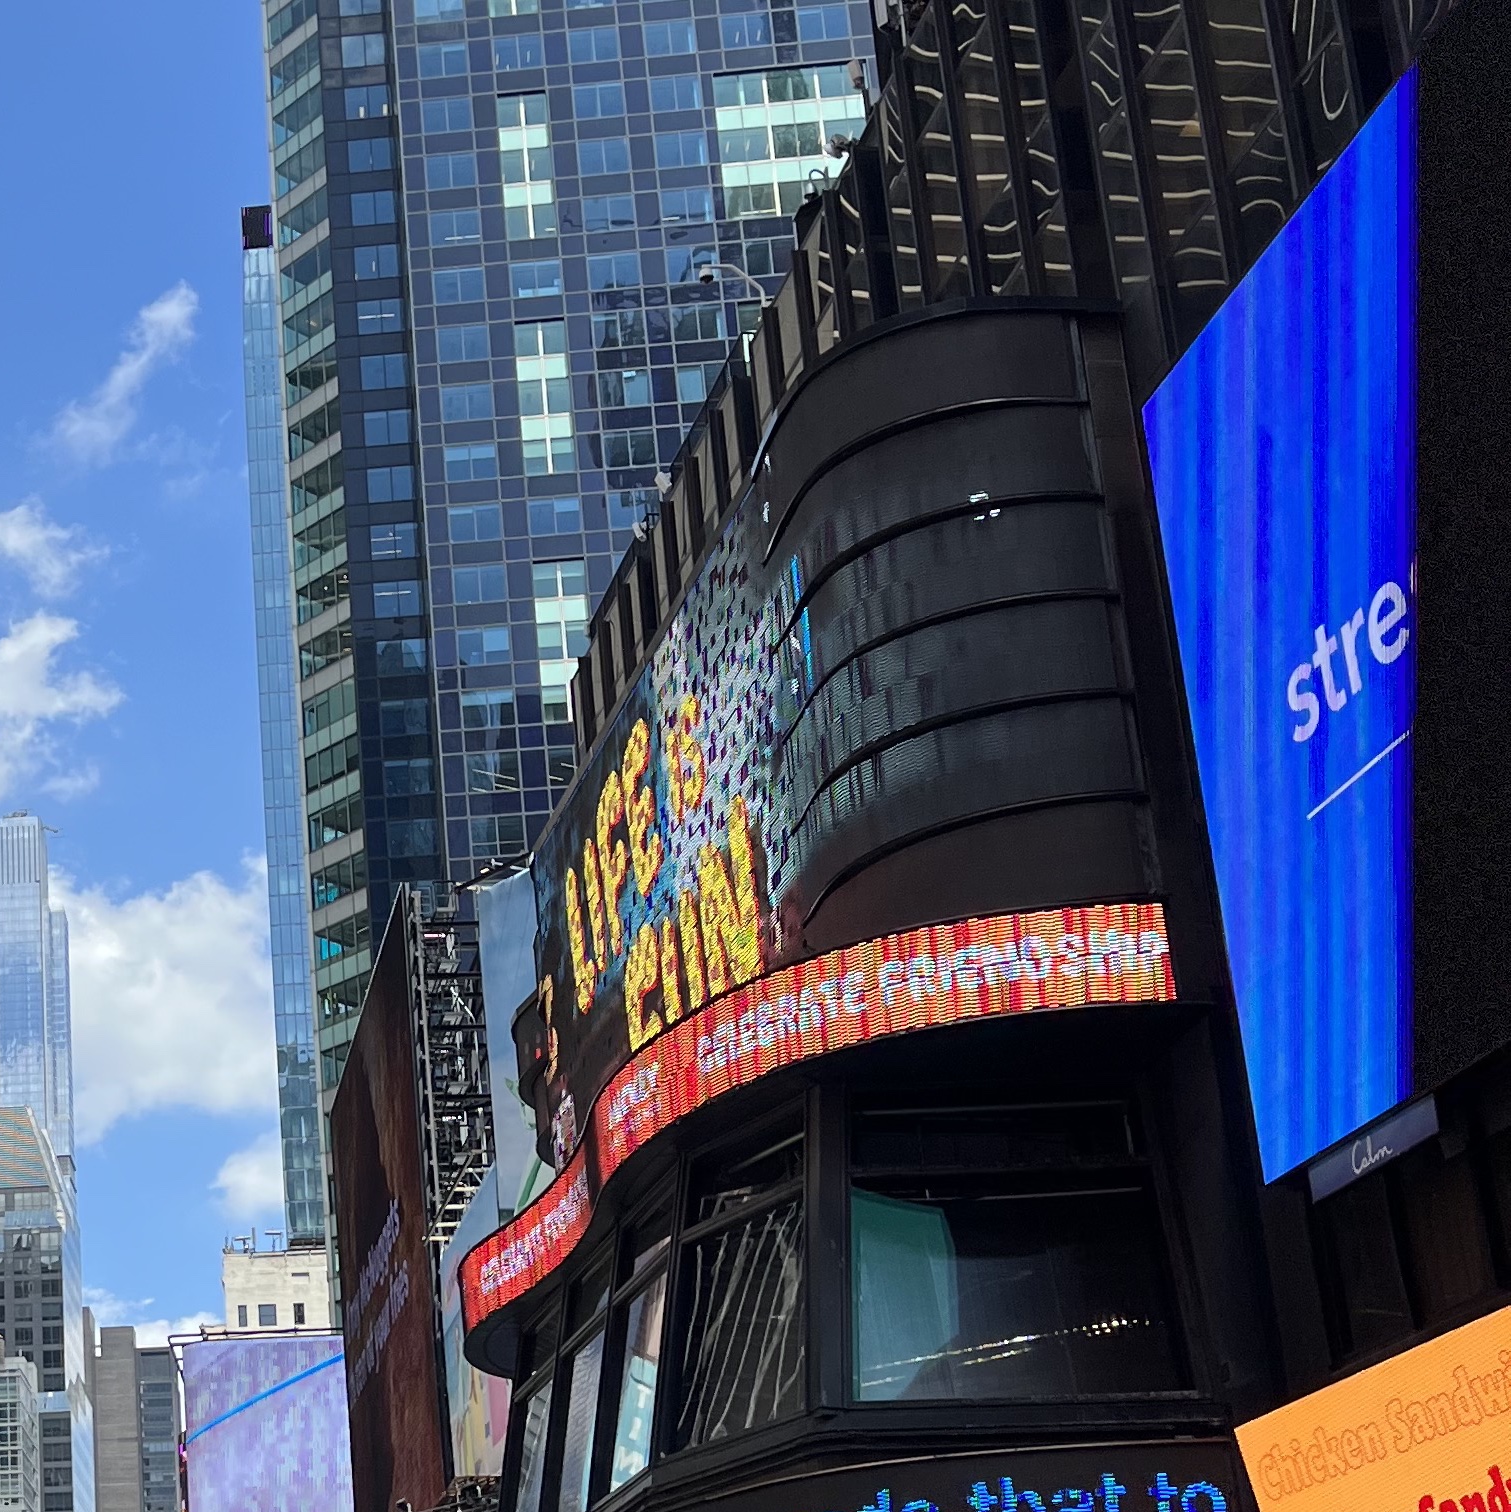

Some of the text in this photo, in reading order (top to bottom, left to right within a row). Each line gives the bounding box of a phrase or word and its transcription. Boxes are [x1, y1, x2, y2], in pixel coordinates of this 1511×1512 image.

[1287, 582, 1410, 743] stre
[566, 718, 664, 1015] LIFE
[666, 695, 706, 824] IS
[878, 928, 1170, 1006] FRIENDSHIP
[1258, 1424, 1387, 1502] Chicken
